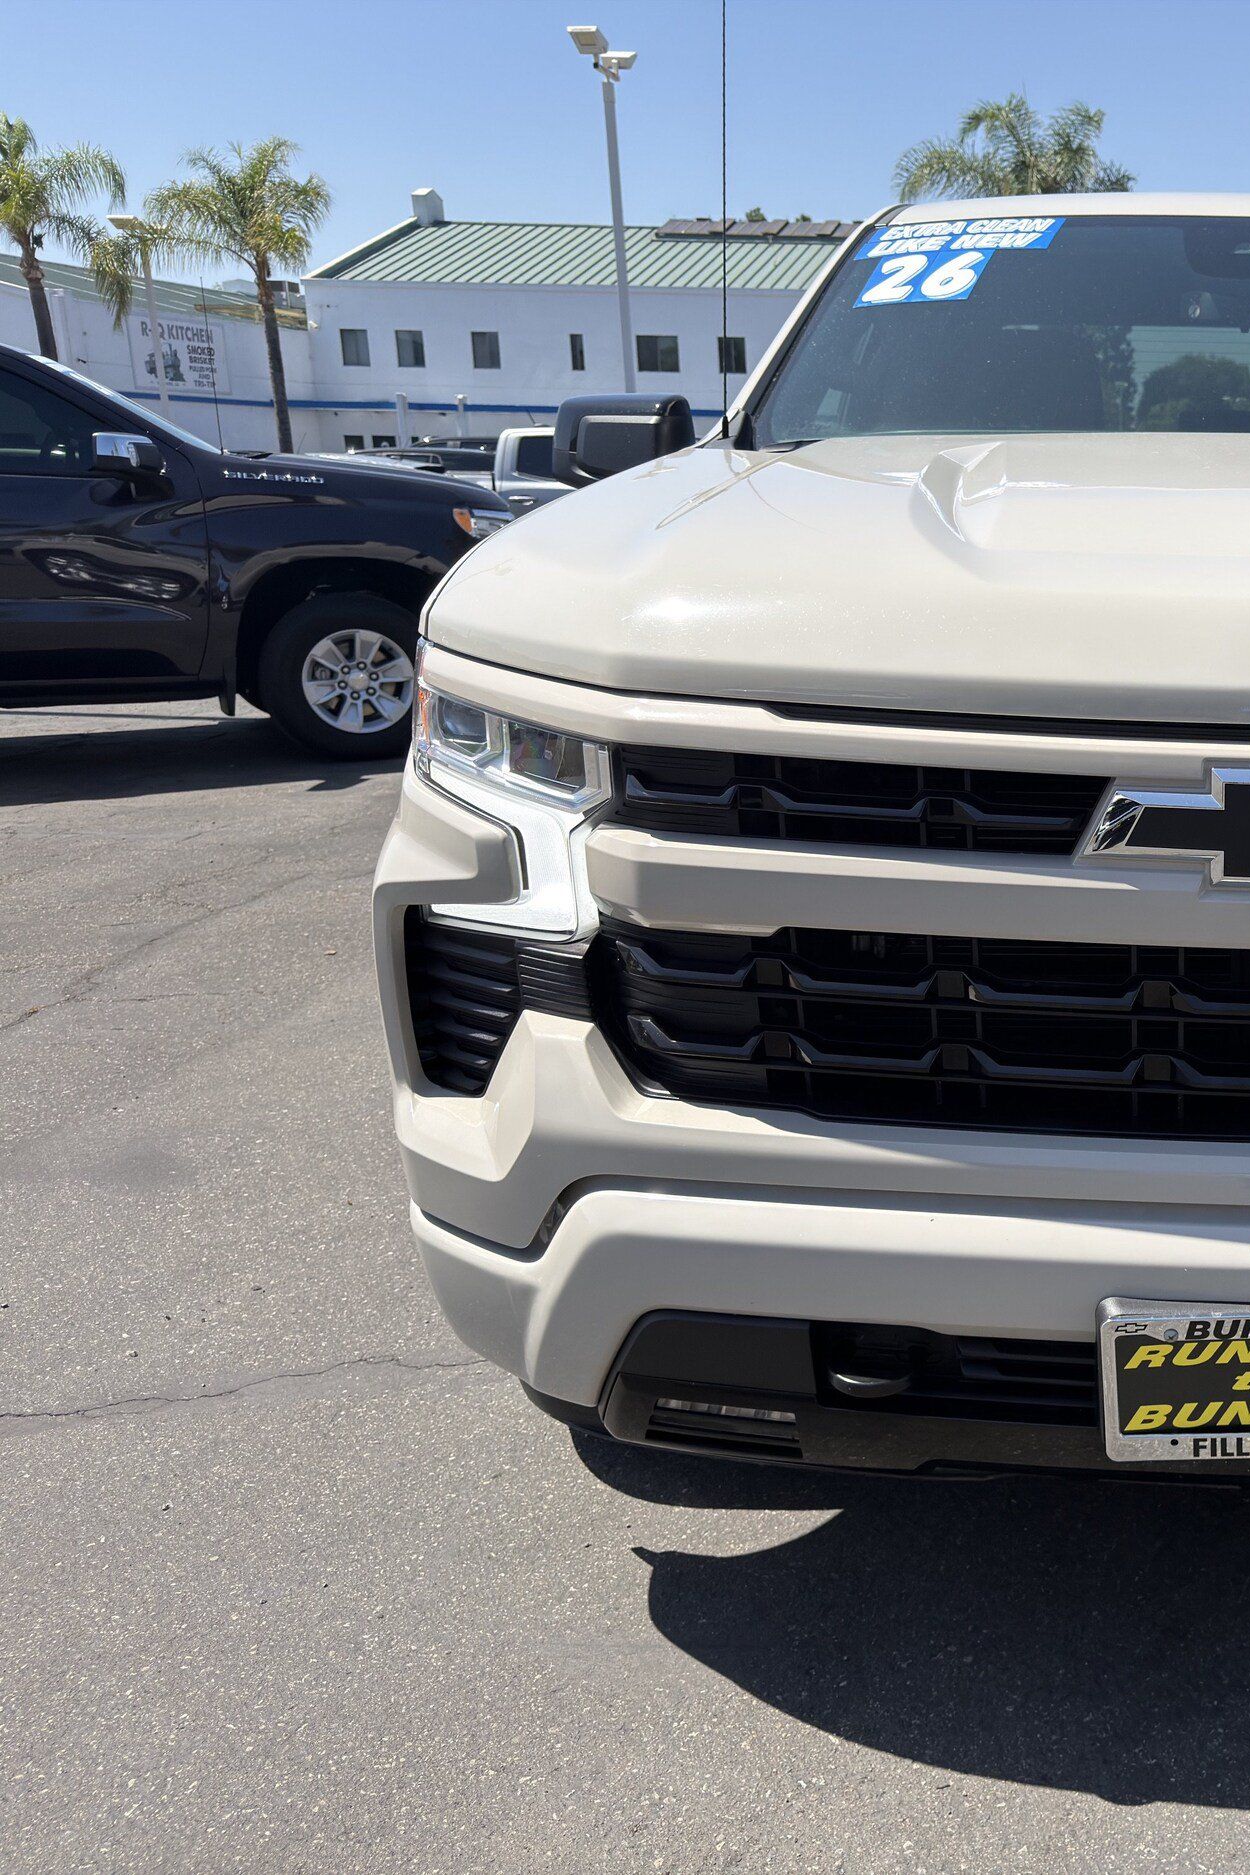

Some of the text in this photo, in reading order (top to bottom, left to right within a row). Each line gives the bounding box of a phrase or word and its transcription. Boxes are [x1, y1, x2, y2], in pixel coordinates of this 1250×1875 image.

[880, 218, 1055, 241] EXTRA CLEAN
[867, 232, 1043, 258] LIKE NEW
[861, 251, 986, 304] 26
[167, 324, 214, 343] KITCHEN
[187, 345, 215, 357] SMOKED
